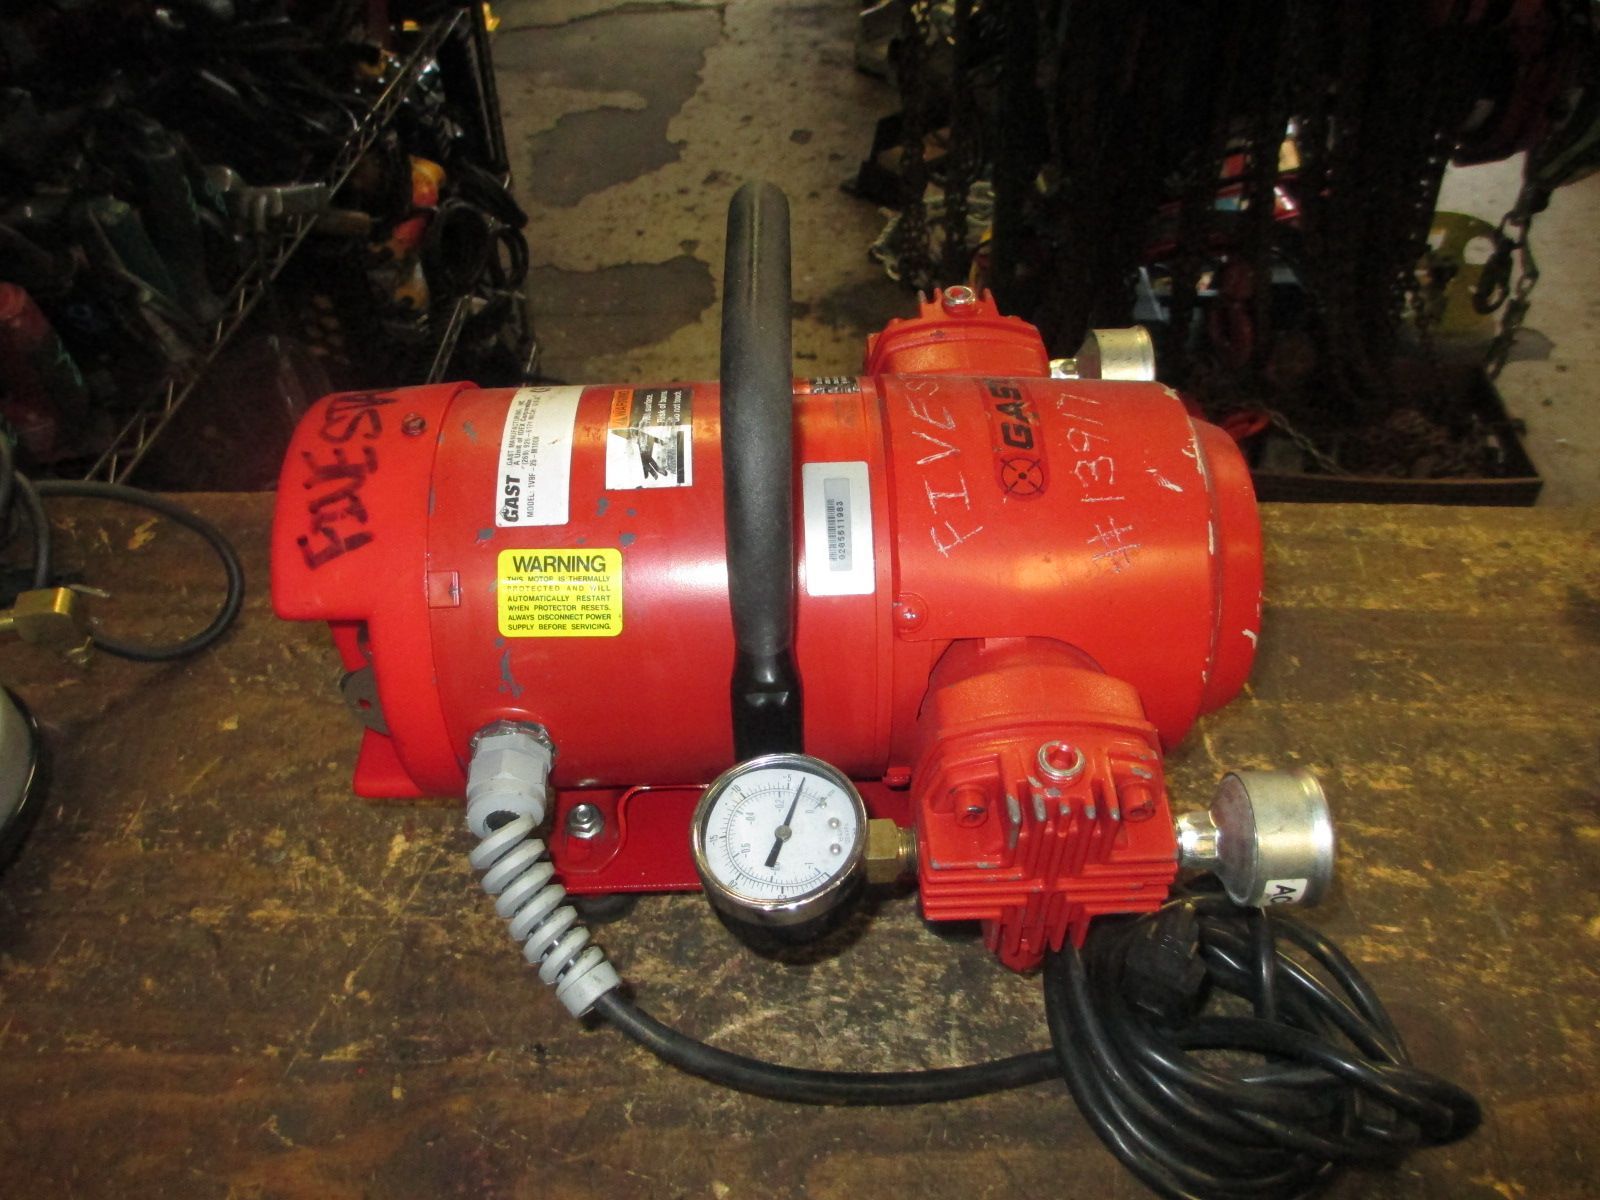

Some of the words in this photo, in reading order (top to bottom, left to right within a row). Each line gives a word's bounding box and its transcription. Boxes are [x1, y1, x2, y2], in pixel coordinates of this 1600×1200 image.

[656, 409, 666, 423] Risk
[988, 377, 1034, 450] GAS
[905, 381, 984, 558] FIVES
[502, 474, 520, 522] GAST
[526, 490, 535, 518] MODEL:
[512, 555, 606, 573] WARNING
